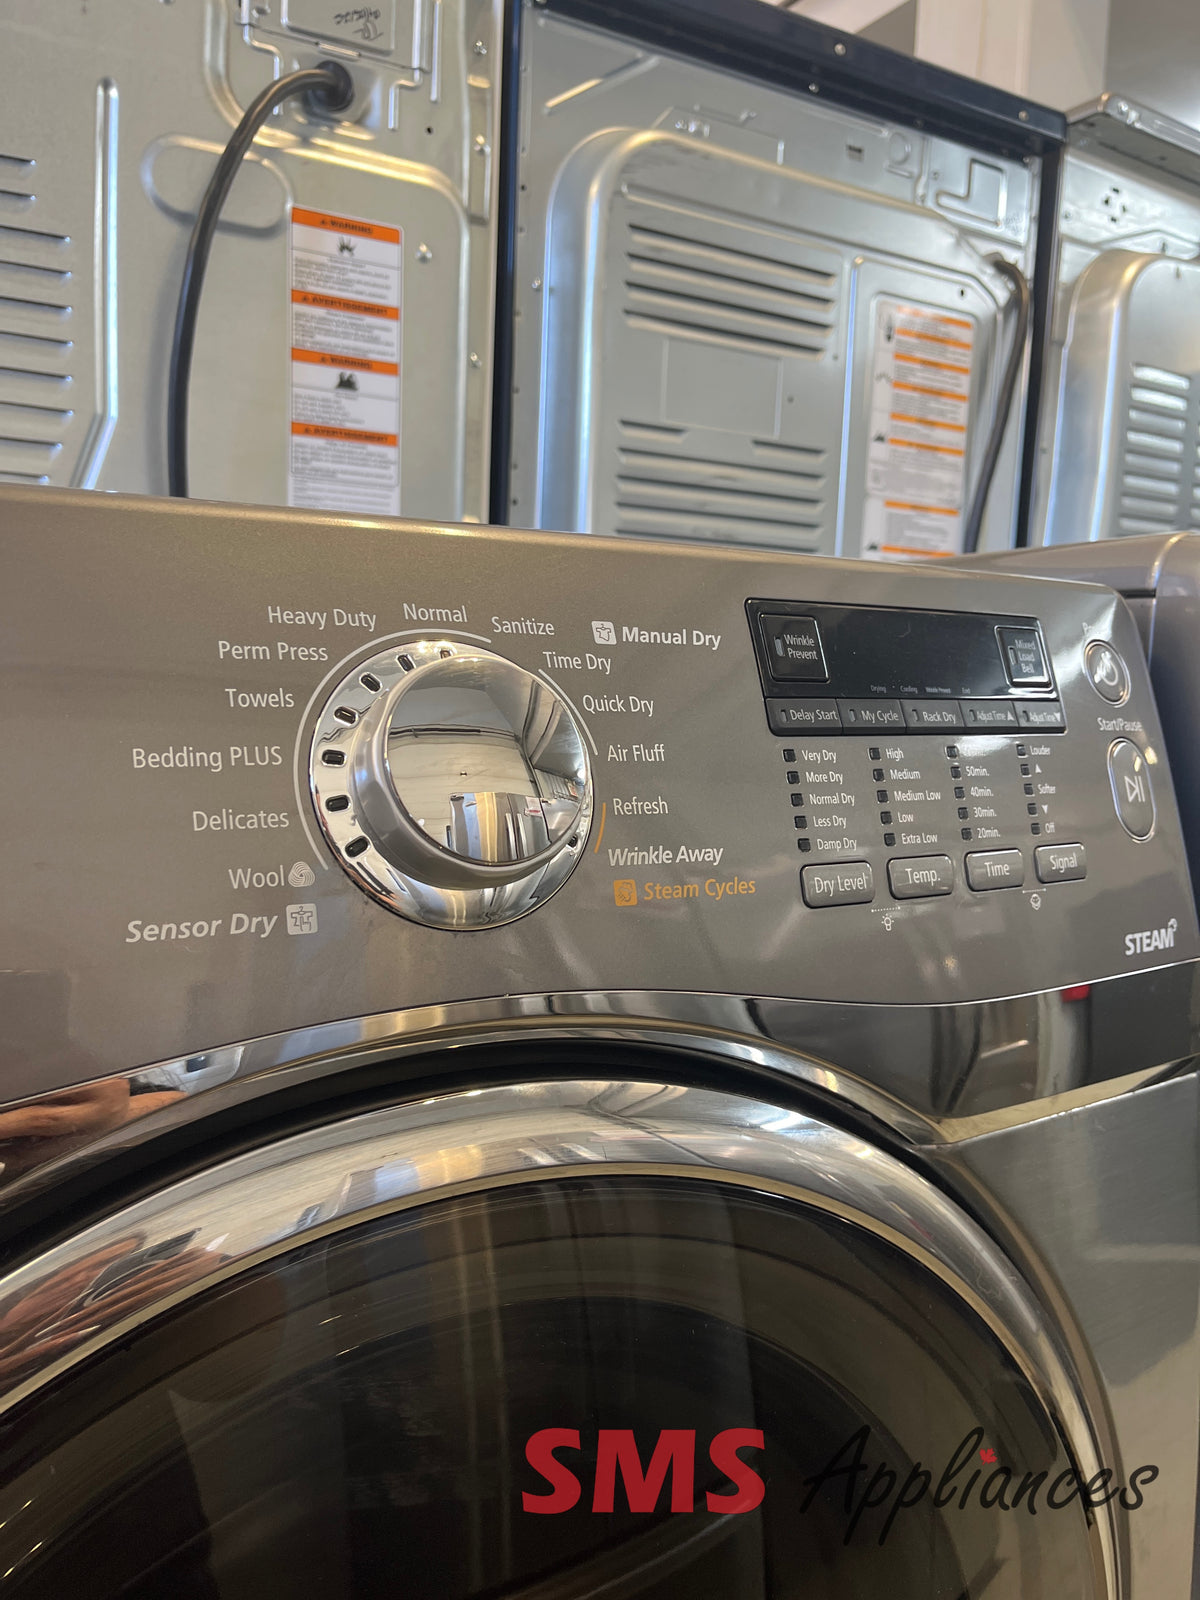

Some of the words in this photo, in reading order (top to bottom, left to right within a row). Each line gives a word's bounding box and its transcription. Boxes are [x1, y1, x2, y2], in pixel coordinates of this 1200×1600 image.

[267, 605, 327, 630] Heavy
[333, 608, 377, 632] Duty
[402, 603, 468, 623] Normal
[491, 616, 555, 635] Sanitize
[622, 626, 687, 645] Manual
[693, 630, 721, 650] Dry
[784, 634, 815, 647] Wrinkle
[1015, 639, 1036, 650] Mixed
[218, 640, 270, 660] Perm
[277, 642, 328, 661] Press
[787, 648, 818, 660] Prevent
[1018, 652, 1035, 662] Load
[542, 651, 581, 670] Time
[585, 653, 611, 674] Dry
[1021, 663, 1034, 673] Bell
[225, 688, 295, 708] Towels
[582, 694, 626, 713] Quick
[629, 696, 654, 717] Dry
[789, 709, 814, 723] Delay
[816, 709, 838, 720] Start
[861, 710, 875, 724] My
[876, 710, 899, 723] Cycle
[922, 711, 942, 722] Rack
[942, 711, 957, 724] Dry
[976, 711, 993, 723] Adjust
[993, 712, 1006, 721] Time
[1097, 717, 1143, 732] Start/Pause
[132, 746, 223, 772] Bedding
[230, 745, 283, 766] PLUS
[607, 744, 628, 762] Air
[633, 744, 665, 762] Fluff
[801, 750, 821, 763] Very
[822, 749, 837, 763] Dry
[886, 748, 904, 761] High
[805, 771, 828, 783] More
[829, 771, 843, 785] Dry
[890, 769, 921, 780] Medium
[965, 766, 990, 776] 50min.
[893, 790, 925, 801] Medium
[926, 790, 941, 800] Low
[970, 786, 994, 797] 40min.
[1037, 783, 1056, 794] Softer
[613, 796, 669, 815] Refresh
[809, 793, 840, 804] Normal
[841, 793, 855, 806] Dry
[897, 812, 914, 823] Low
[974, 807, 997, 817] 30min.
[192, 809, 290, 831] Delicates
[813, 816, 831, 827] Less
[832, 815, 847, 829] Dry
[901, 833, 921, 844] Extra
[922, 832, 938, 843] Low
[977, 827, 1001, 838] 20min.
[816, 838, 842, 852] Damp
[843, 837, 857, 851] Dry
[608, 845, 672, 867] Wrinkle
[675, 845, 724, 866] Away
[1050, 852, 1078, 873] Signal
[984, 861, 1010, 877] Time
[228, 865, 285, 889] Wool
[905, 868, 941, 886] Temp.
[644, 882, 699, 900] Steam
[704, 876, 756, 901] Cycles
[814, 876, 835, 897] Dry
[837, 872, 867, 891] Level
[125, 919, 222, 943] Sensor
[230, 913, 279, 938] Dry
[1125, 928, 1175, 956] STEAM
